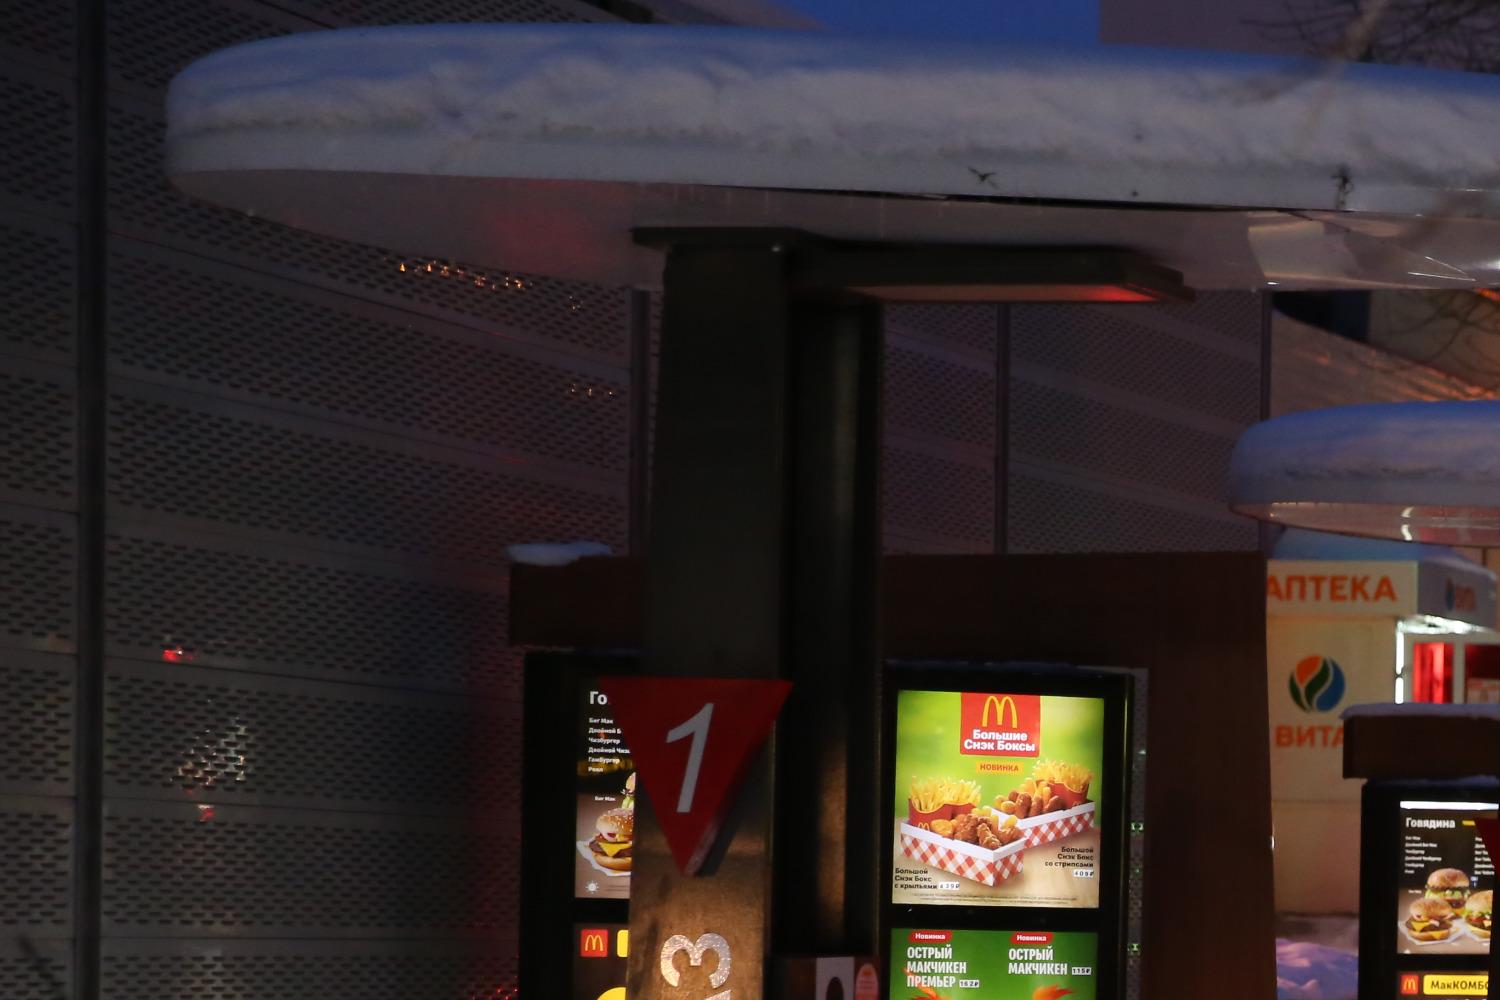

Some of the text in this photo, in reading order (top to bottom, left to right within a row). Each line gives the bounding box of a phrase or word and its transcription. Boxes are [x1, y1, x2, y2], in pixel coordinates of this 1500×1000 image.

[1267, 575, 1398, 603] АПТЕКА
[589, 691, 608, 705] Го
[973, 729, 1028, 742] Большие
[964, 739, 1036, 752] Снэк Боксы
[665, 702, 714, 813] 1
[980, 763, 1019, 772] НОВИНКА
[1405, 817, 1456, 829] Говядина
[915, 875, 932, 883] Бокс
[915, 932, 946, 940] Новинка
[1016, 934, 1047, 942] Новинка
[907, 944, 953, 959] ОСТРЫЙ
[1008, 945, 1054, 961] ОСТРЫЙ
[906, 961, 967, 974] МАКЧИКЕН
[1008, 962, 1068, 975] МАКЧИКЕН
[906, 975, 956, 988] ПРЕМЬЕР
